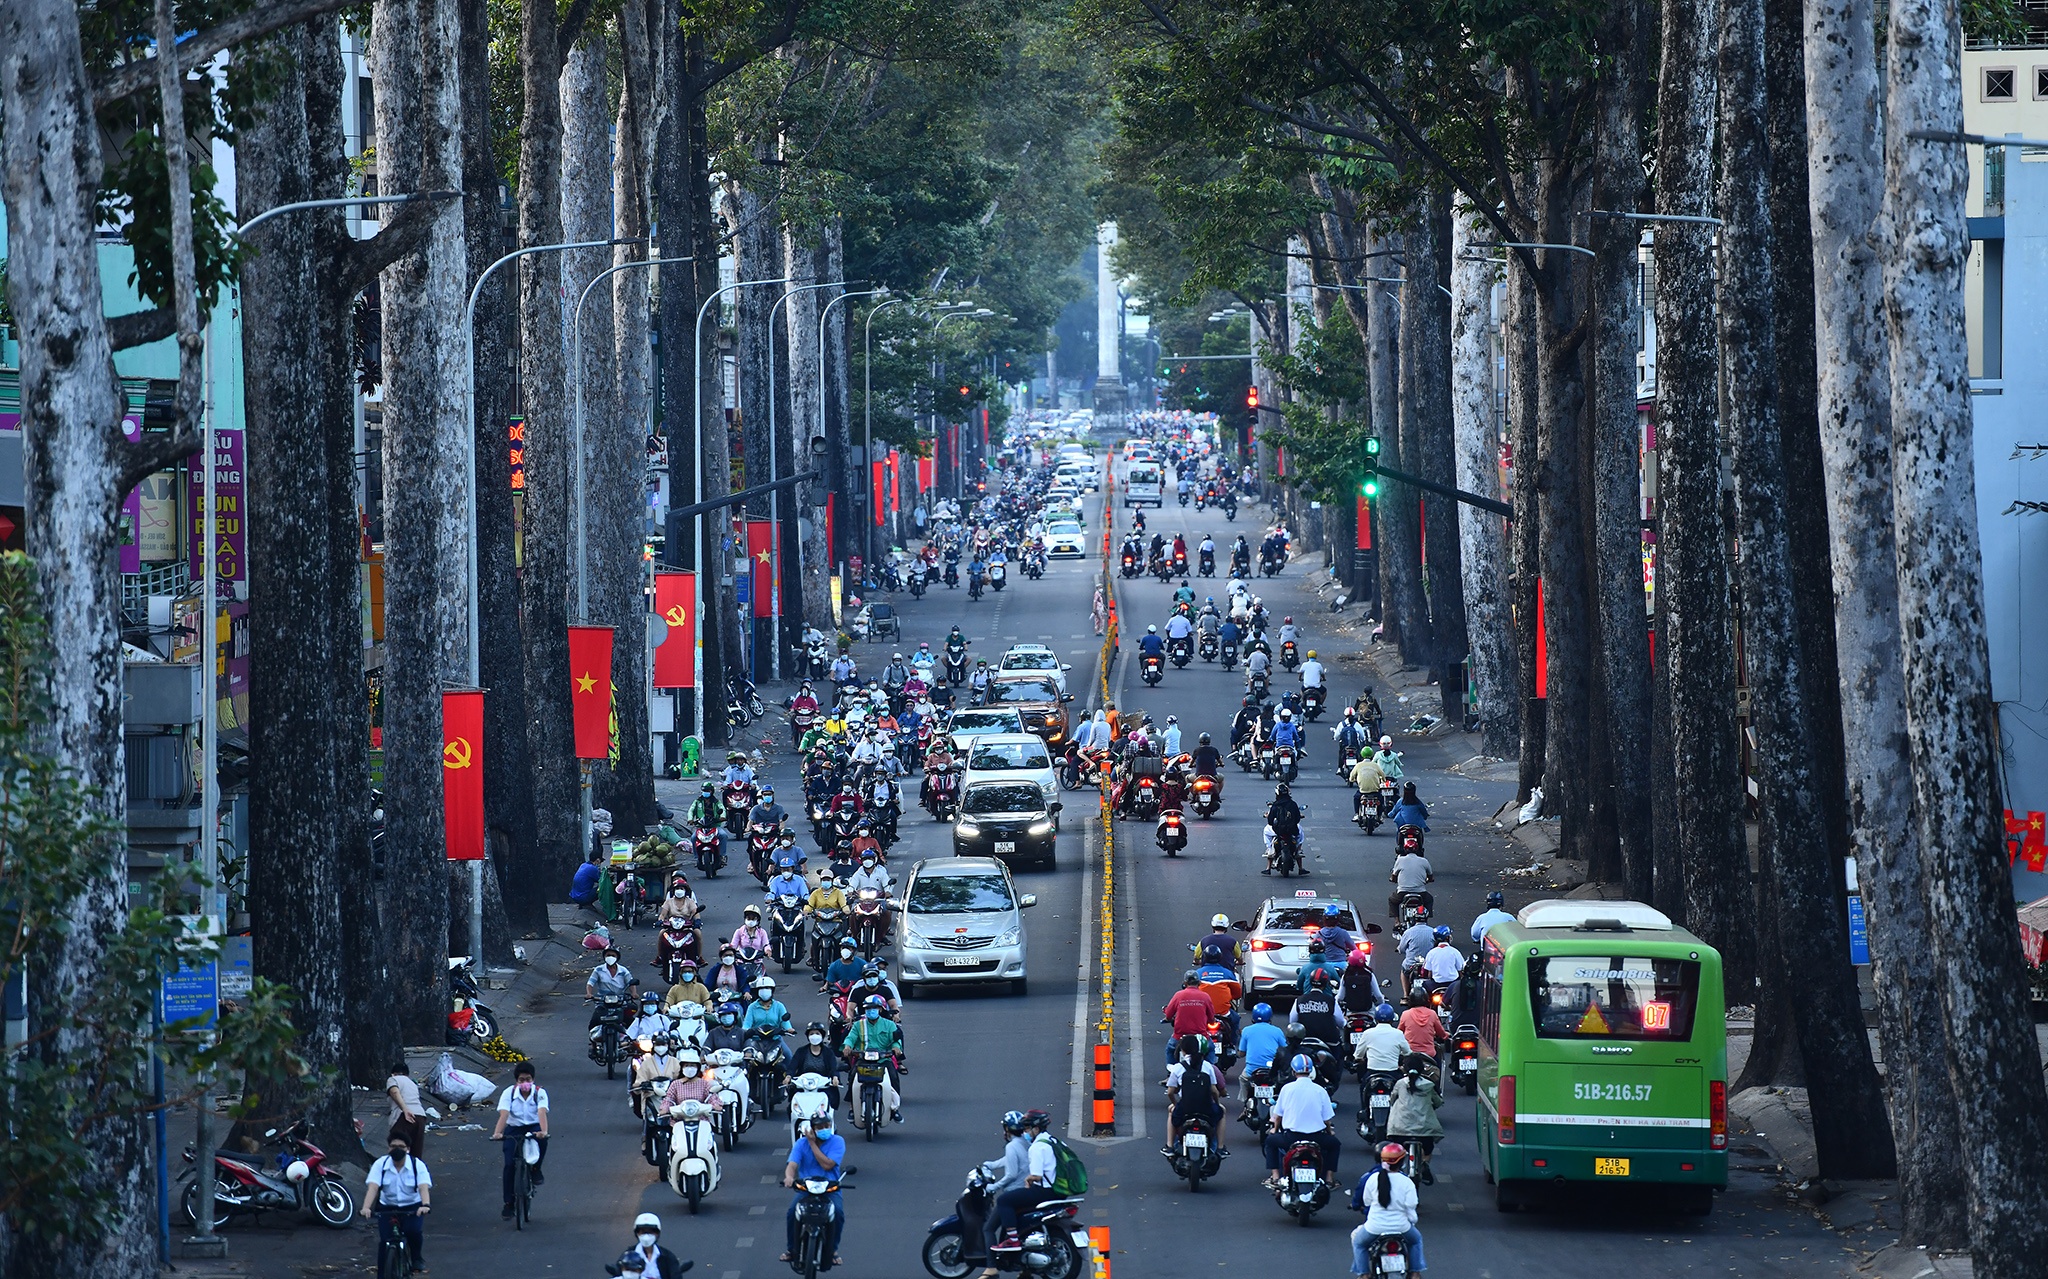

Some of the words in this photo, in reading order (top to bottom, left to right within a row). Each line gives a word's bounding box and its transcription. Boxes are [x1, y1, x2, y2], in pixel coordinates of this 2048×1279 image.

[1574, 968, 1656, 980] SaigonBus
[1645, 1003, 1668, 1028] 07
[1574, 1083, 1652, 1101] 51B-216.57
[1599, 1166, 1626, 1174] 216.57
